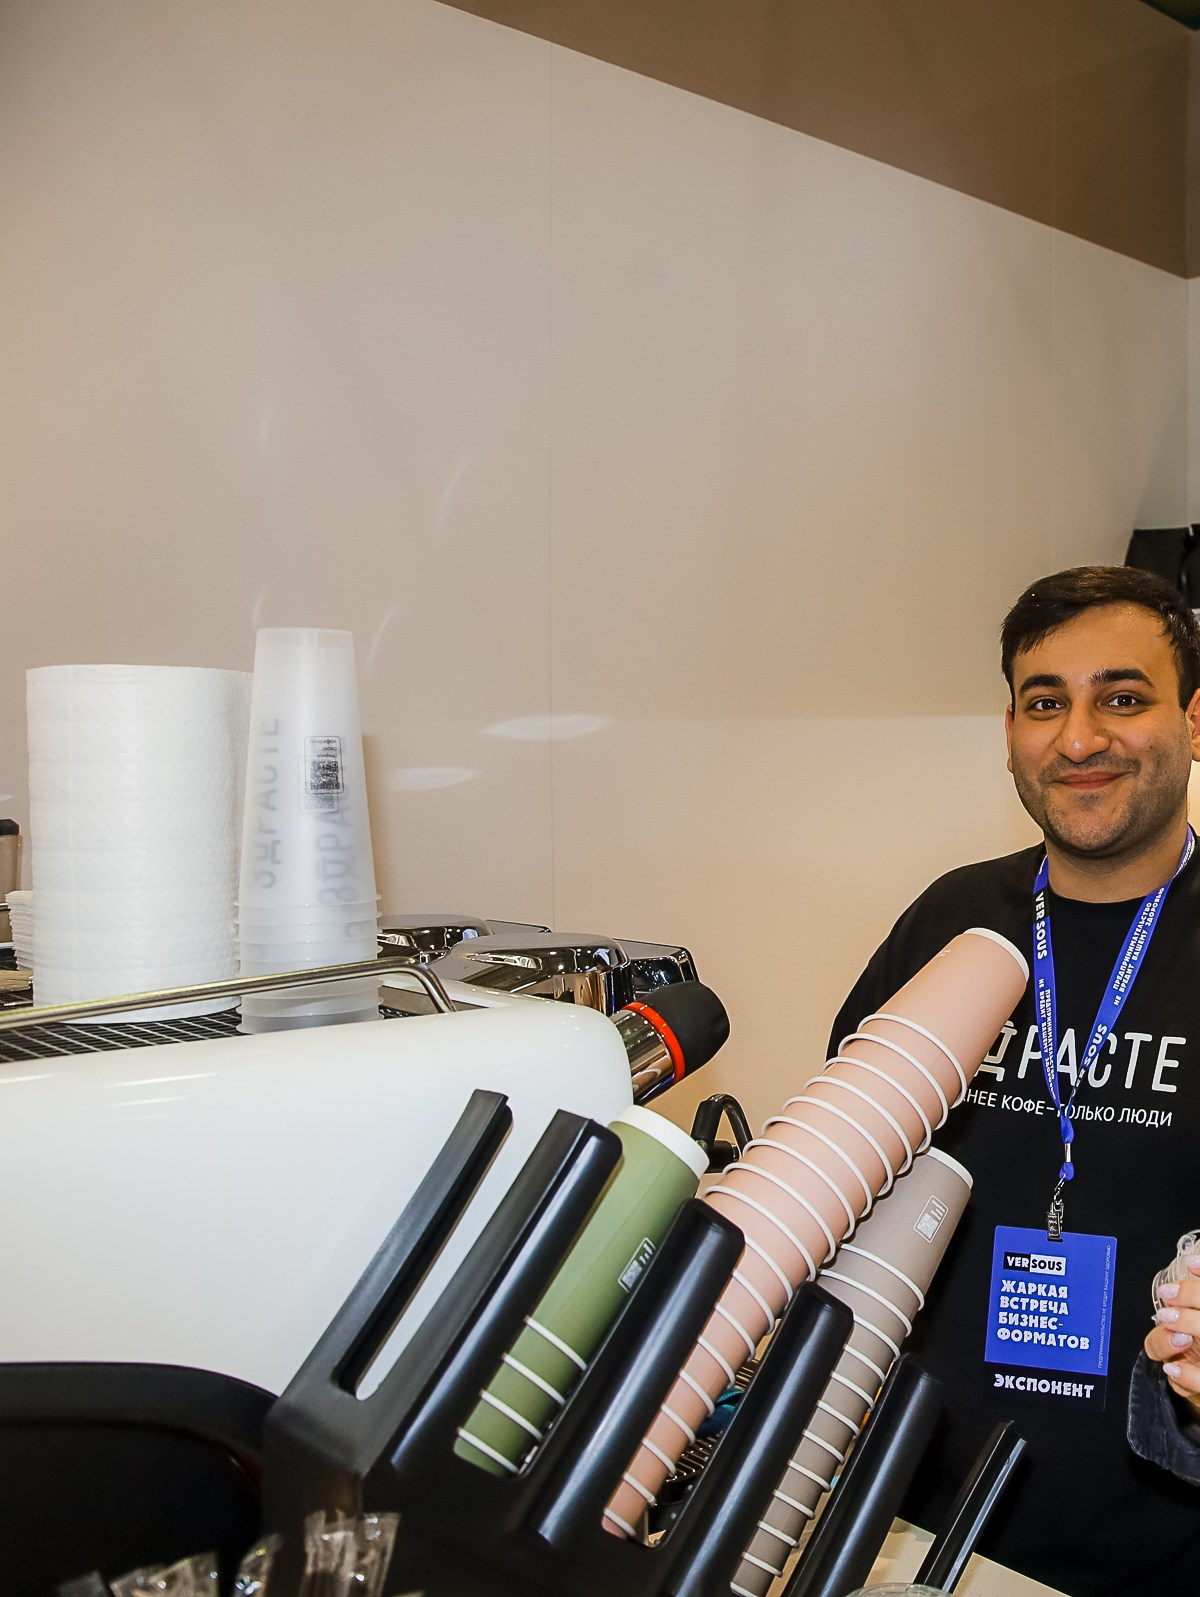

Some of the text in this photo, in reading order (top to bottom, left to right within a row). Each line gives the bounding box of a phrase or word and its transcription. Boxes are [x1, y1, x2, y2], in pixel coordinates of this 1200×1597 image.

[1112, 901, 1153, 991] ПРЕДПРИНИМАТЕЛЬСТВО
[1113, 887, 1165, 1006] НЕ ВРЕДИТ ВАШЕМУ ЗДОРОВЬЮ
[1118, 1107, 1173, 1128] ЛЮДИ
[1006, 1255, 1063, 1272] VERSOUS
[1000, 1279, 1068, 1299] ЖАРКАЯ
[1000, 1296, 1069, 1316] ВСТРЕЧА
[998, 1312, 1064, 1330] БИЗНЕС-
[997, 1327, 1090, 1350] ФОРМАТОВ
[994, 1374, 1095, 1399] ЭКСПОНЕНТ
